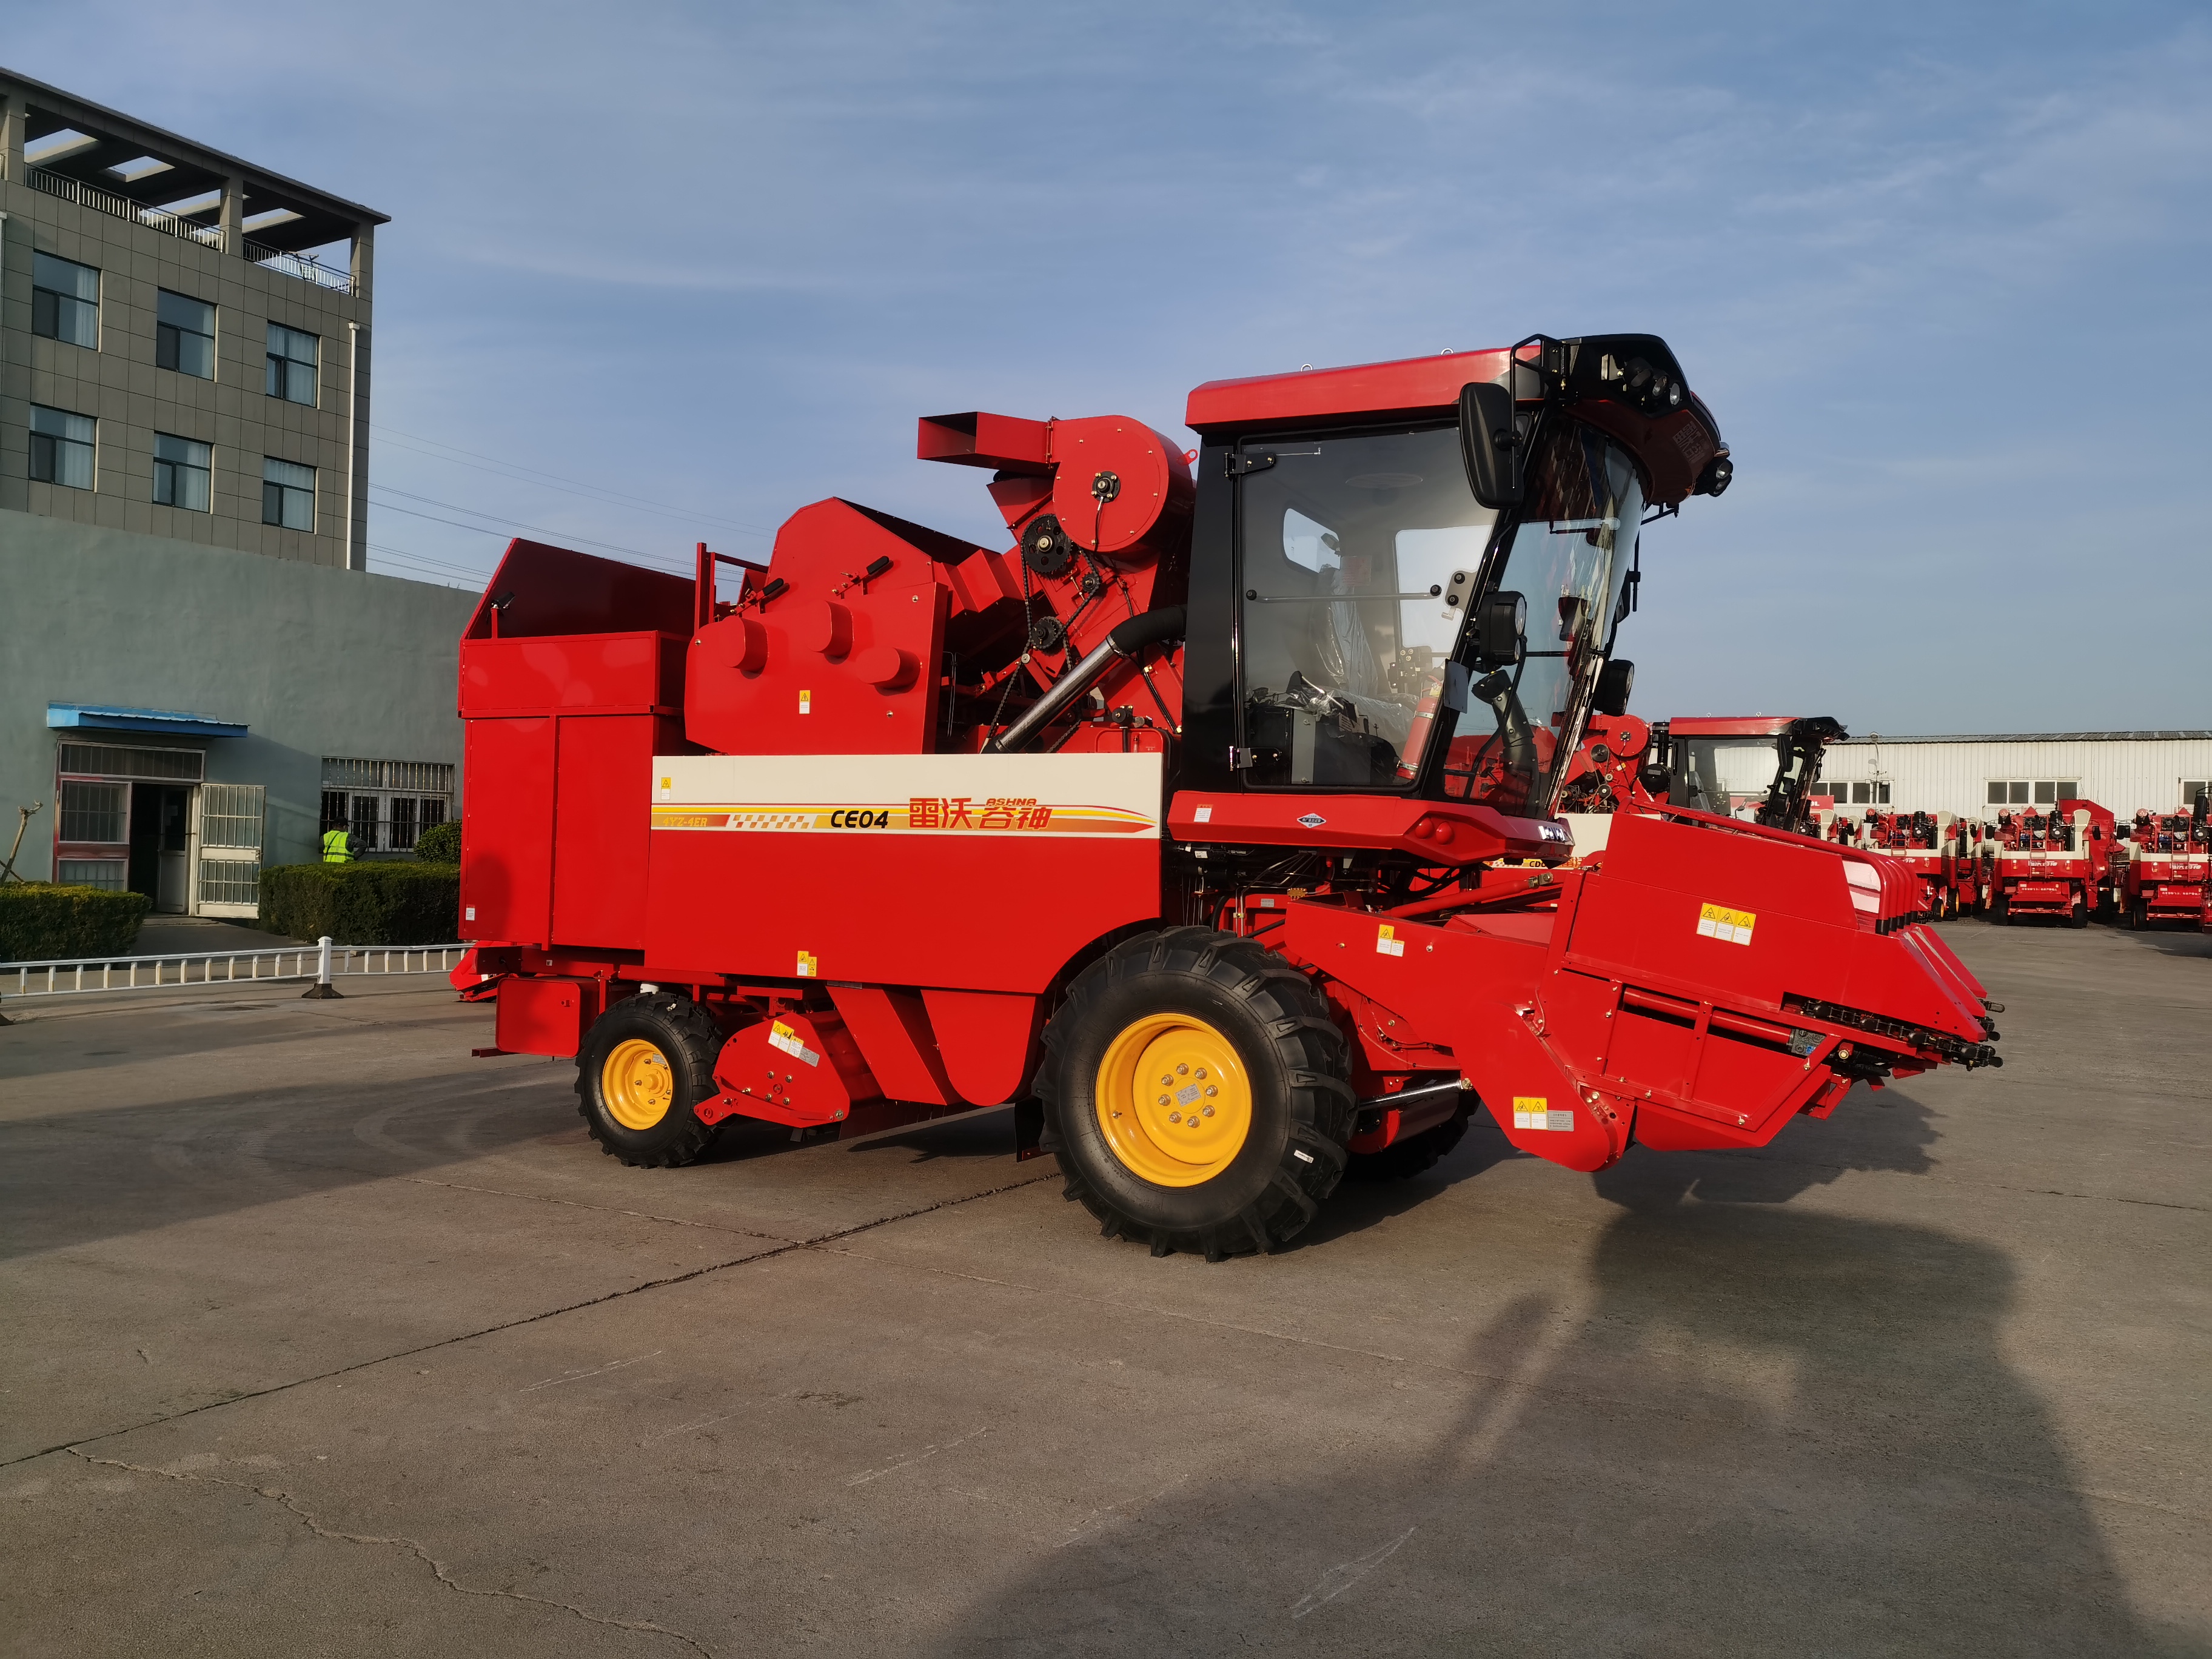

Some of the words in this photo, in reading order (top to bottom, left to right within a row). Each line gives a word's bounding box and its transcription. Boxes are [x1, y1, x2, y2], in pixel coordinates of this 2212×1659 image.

[985, 798, 1037, 806] ASHNA
[830, 810, 889, 829] CE04
[909, 797, 1053, 831] 雷沃谷神
[663, 817, 708, 827] 4YZ-4ER
